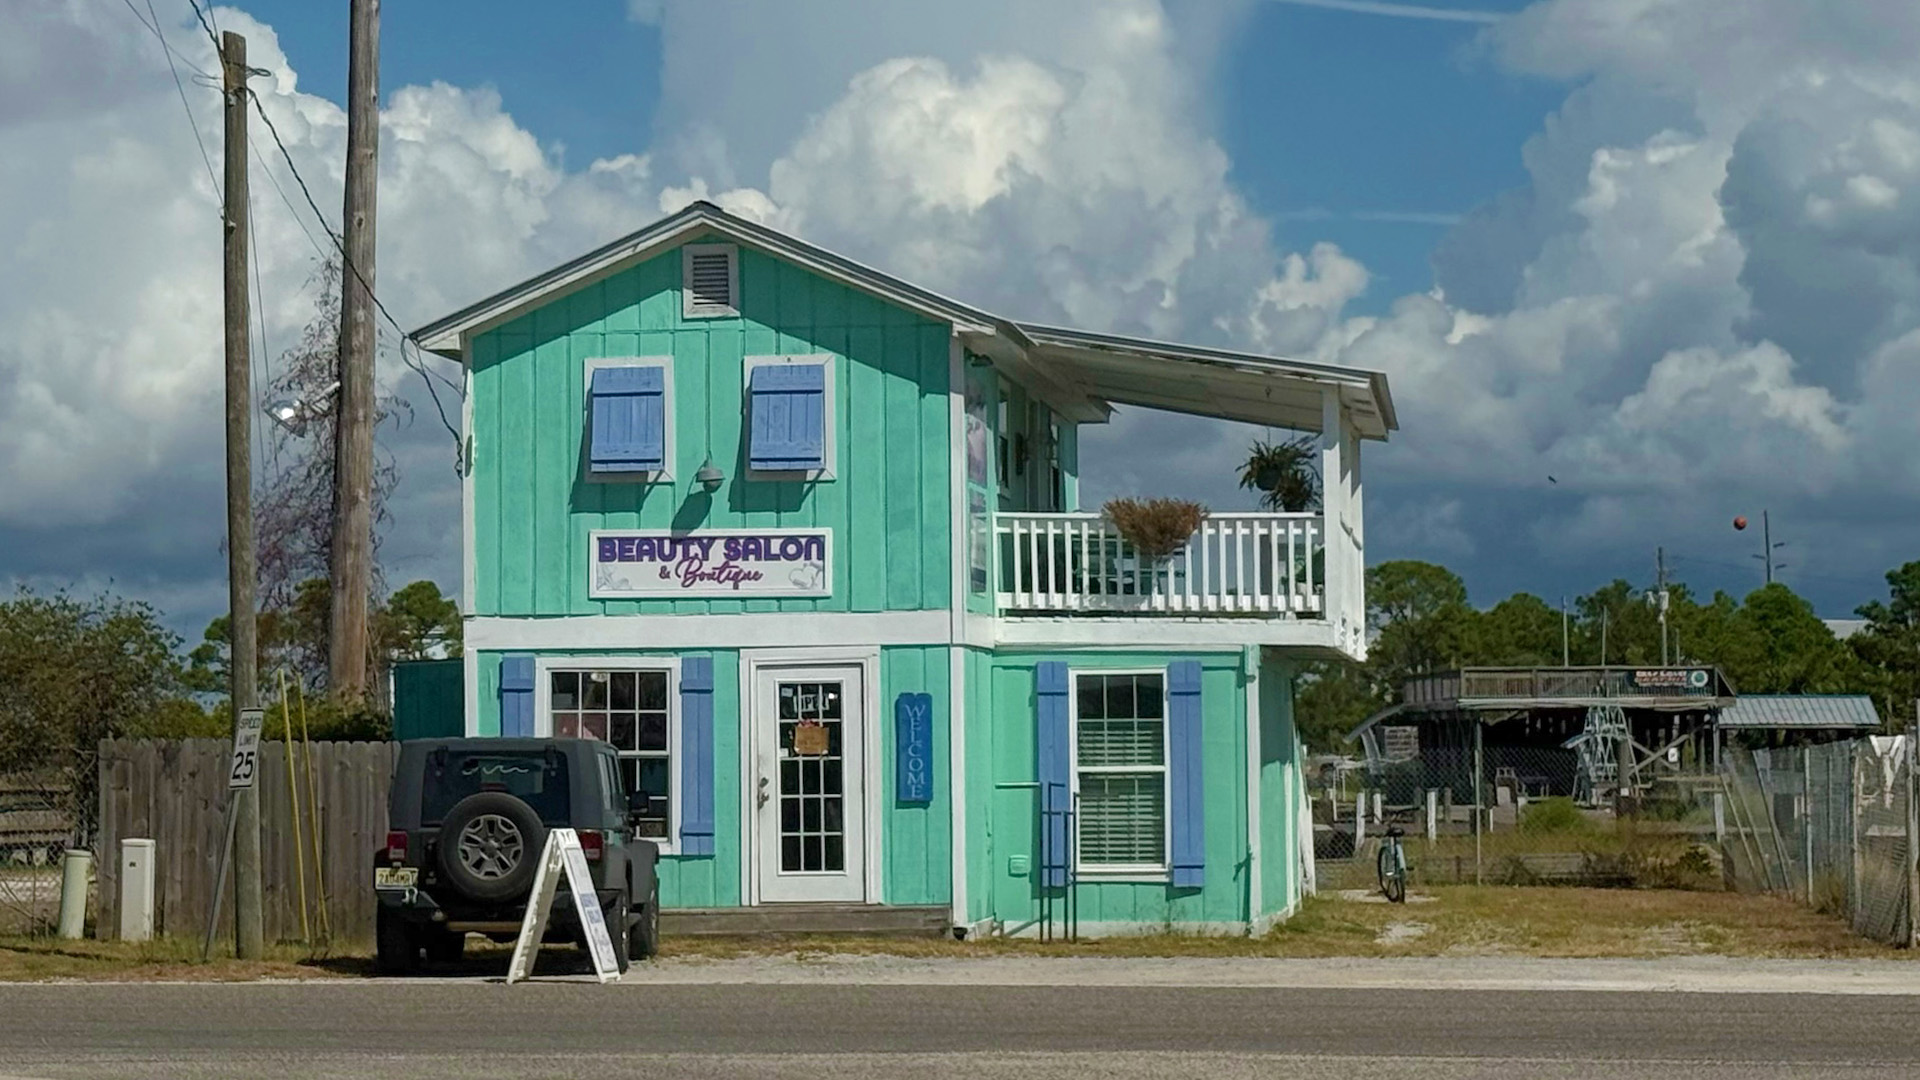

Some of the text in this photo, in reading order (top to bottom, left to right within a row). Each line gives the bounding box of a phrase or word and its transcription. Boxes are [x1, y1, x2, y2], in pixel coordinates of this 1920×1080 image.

[598, 537, 824, 562] BEAUTY SALON
[659, 556, 764, 590] & Boutique
[239, 716, 262, 729] SPEED
[238, 734, 257, 747] LIMIT
[903, 704, 927, 799] WELCOME
[232, 751, 255, 780] 25
